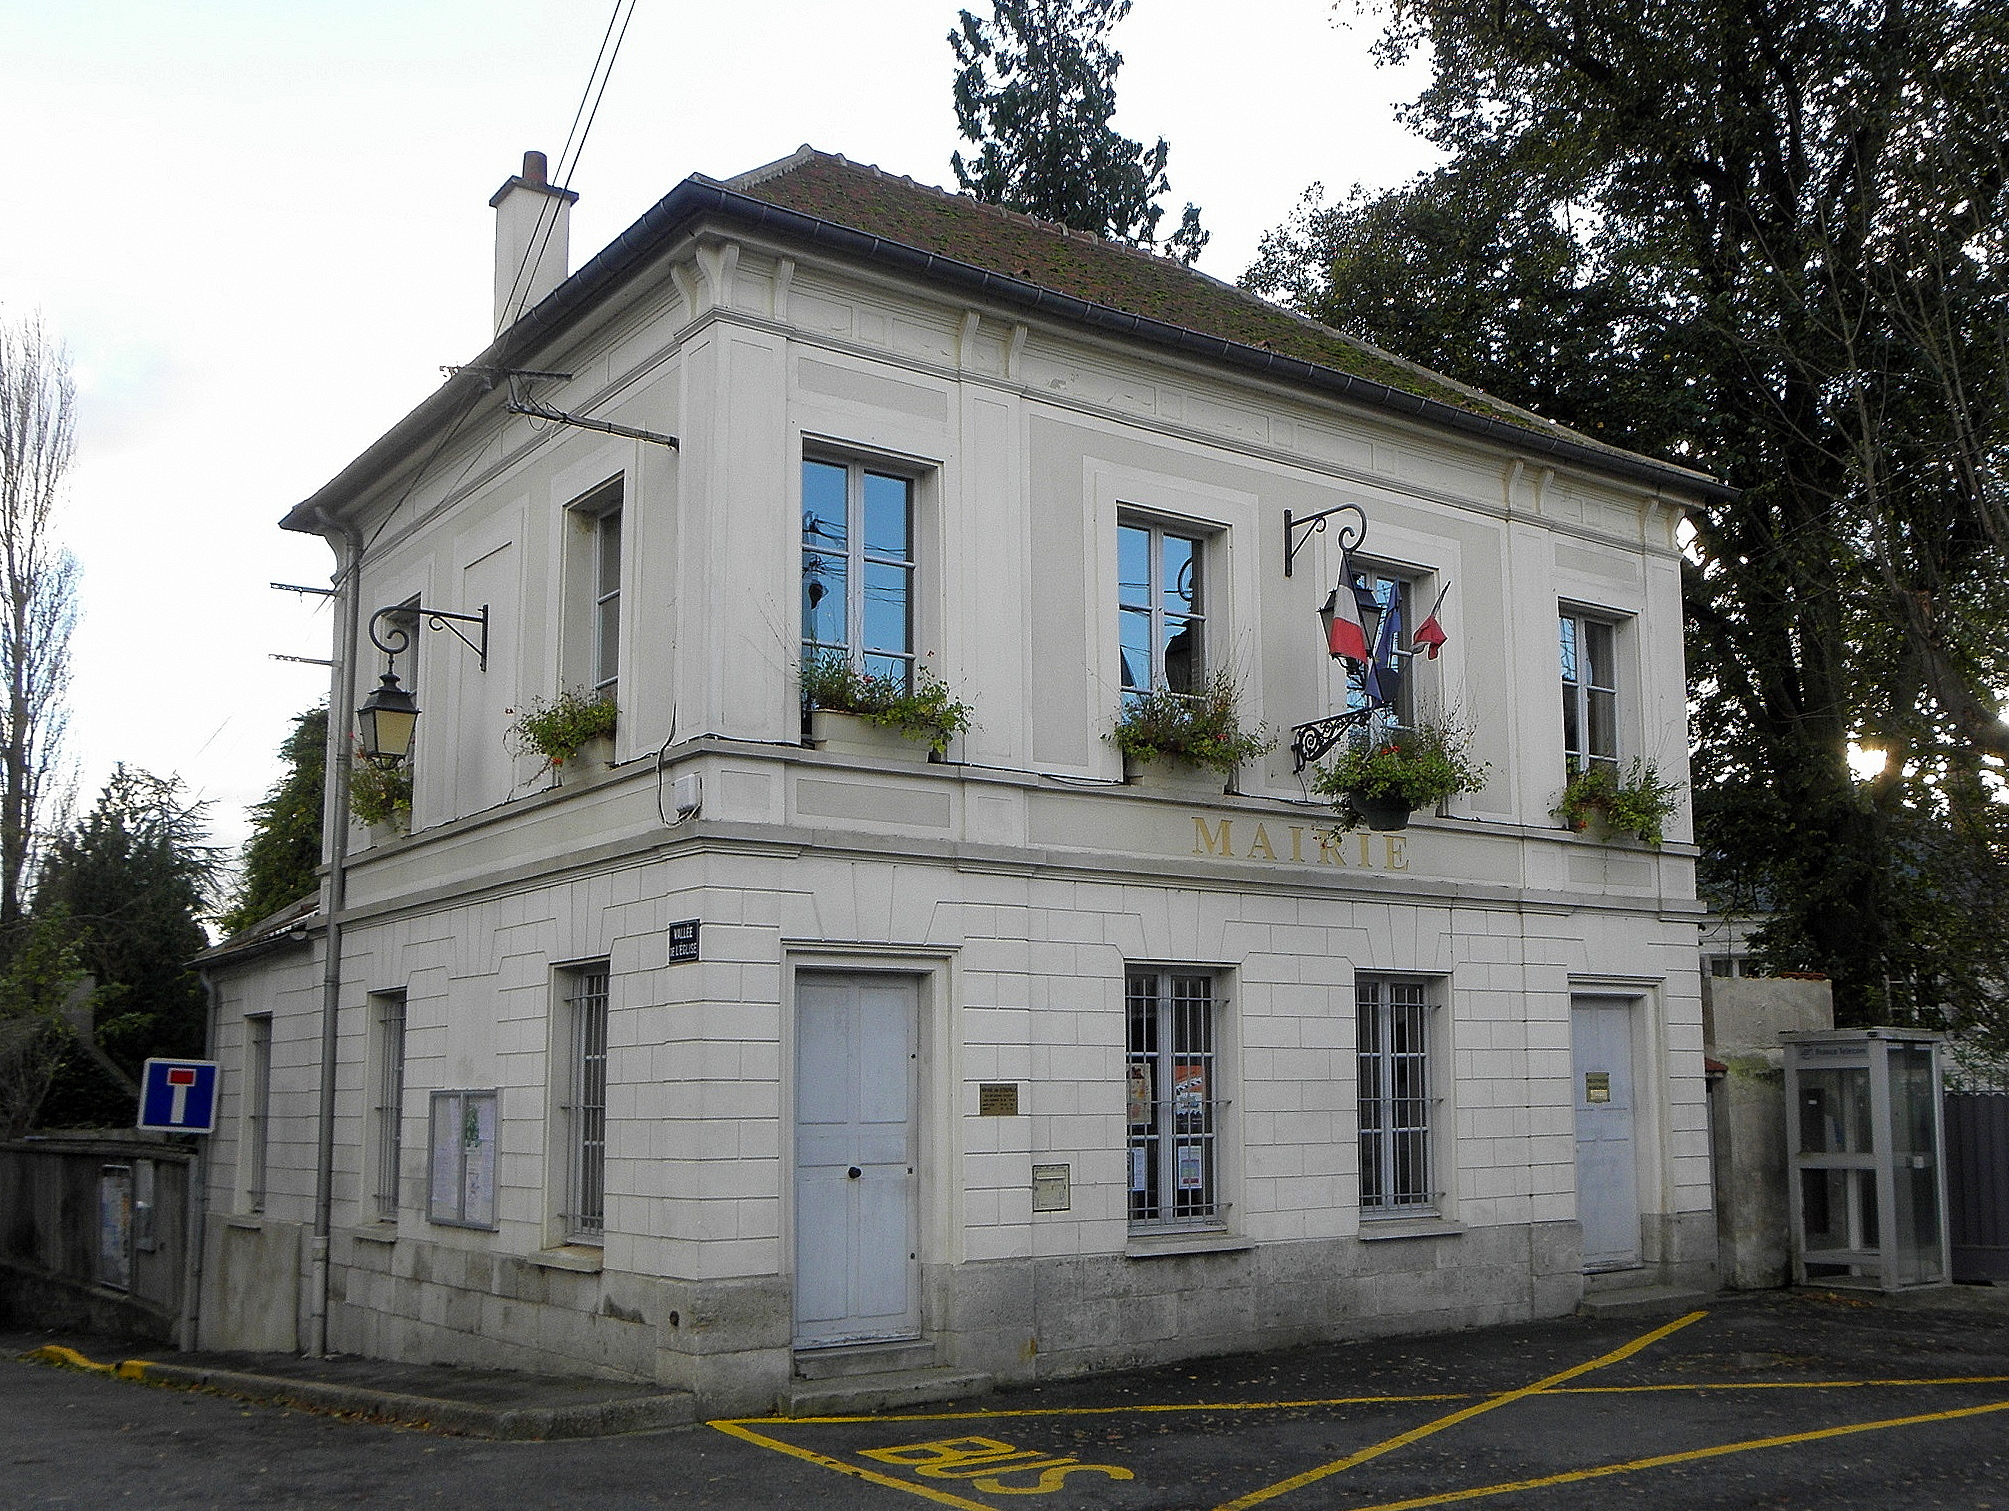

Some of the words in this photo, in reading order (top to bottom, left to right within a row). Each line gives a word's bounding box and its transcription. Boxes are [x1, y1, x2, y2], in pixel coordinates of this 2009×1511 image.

[1191, 816, 1411, 871] MAIRIE
[673, 924, 694, 940] VALLÉE
[856, 1435, 1136, 1495] BUS
